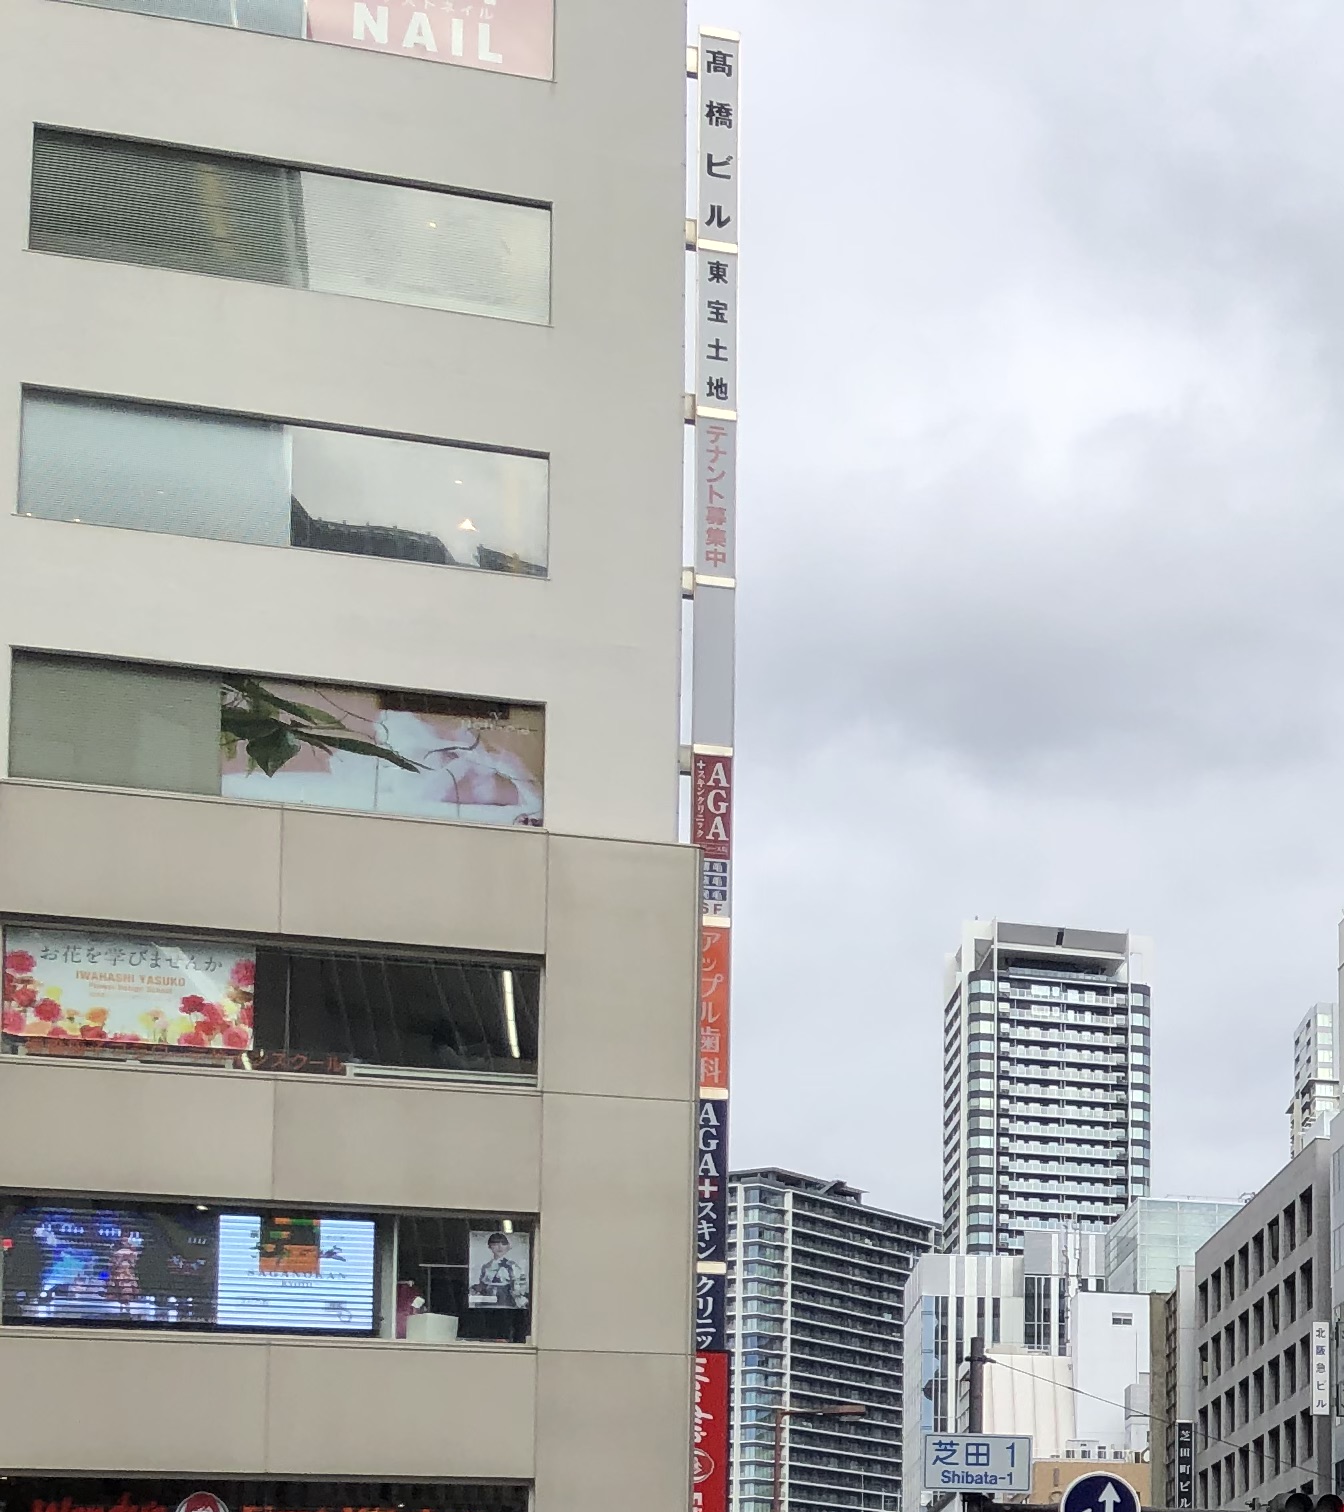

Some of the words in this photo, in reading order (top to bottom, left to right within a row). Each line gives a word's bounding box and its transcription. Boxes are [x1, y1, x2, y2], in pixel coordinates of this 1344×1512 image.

[353, 2, 503, 64] NAIL
[706, 260, 729, 401] 東宝土地
[706, 425, 729, 568] テナント募集中
[706, 762, 730, 841] AGA
[40, 943, 223, 973] お花を学びませんか
[698, 1102, 721, 1177] AGA
[1315, 1327, 1327, 1408] 北阪急ビル
[932, 1440, 990, 1467] 芝田
[1005, 1442, 1016, 1468] 1
[941, 1469, 1013, 1486] Shibata-1
